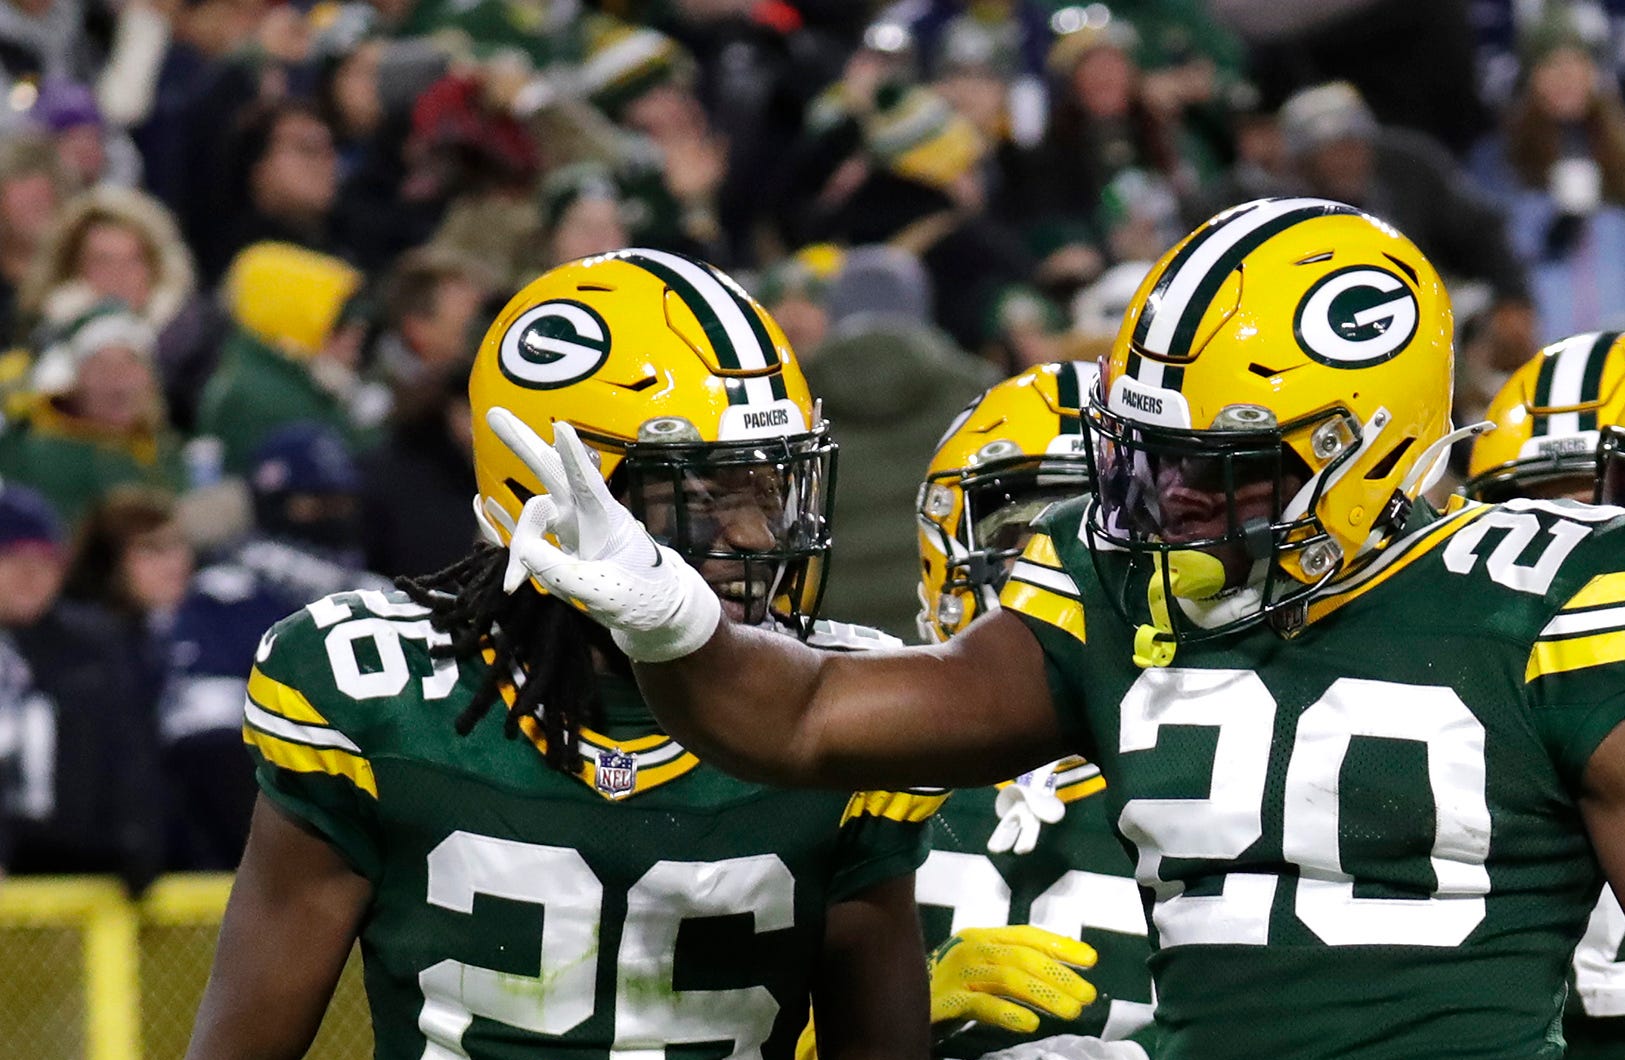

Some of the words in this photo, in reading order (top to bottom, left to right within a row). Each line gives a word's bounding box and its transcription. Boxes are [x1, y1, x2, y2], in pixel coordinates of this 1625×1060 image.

[1299, 269, 1416, 362] G
[502, 303, 609, 385] G
[744, 408, 789, 430] PACKERS
[1122, 387, 1163, 415] PACKERS
[601, 768, 630, 789] NFL
[1119, 667, 1492, 948] 20
